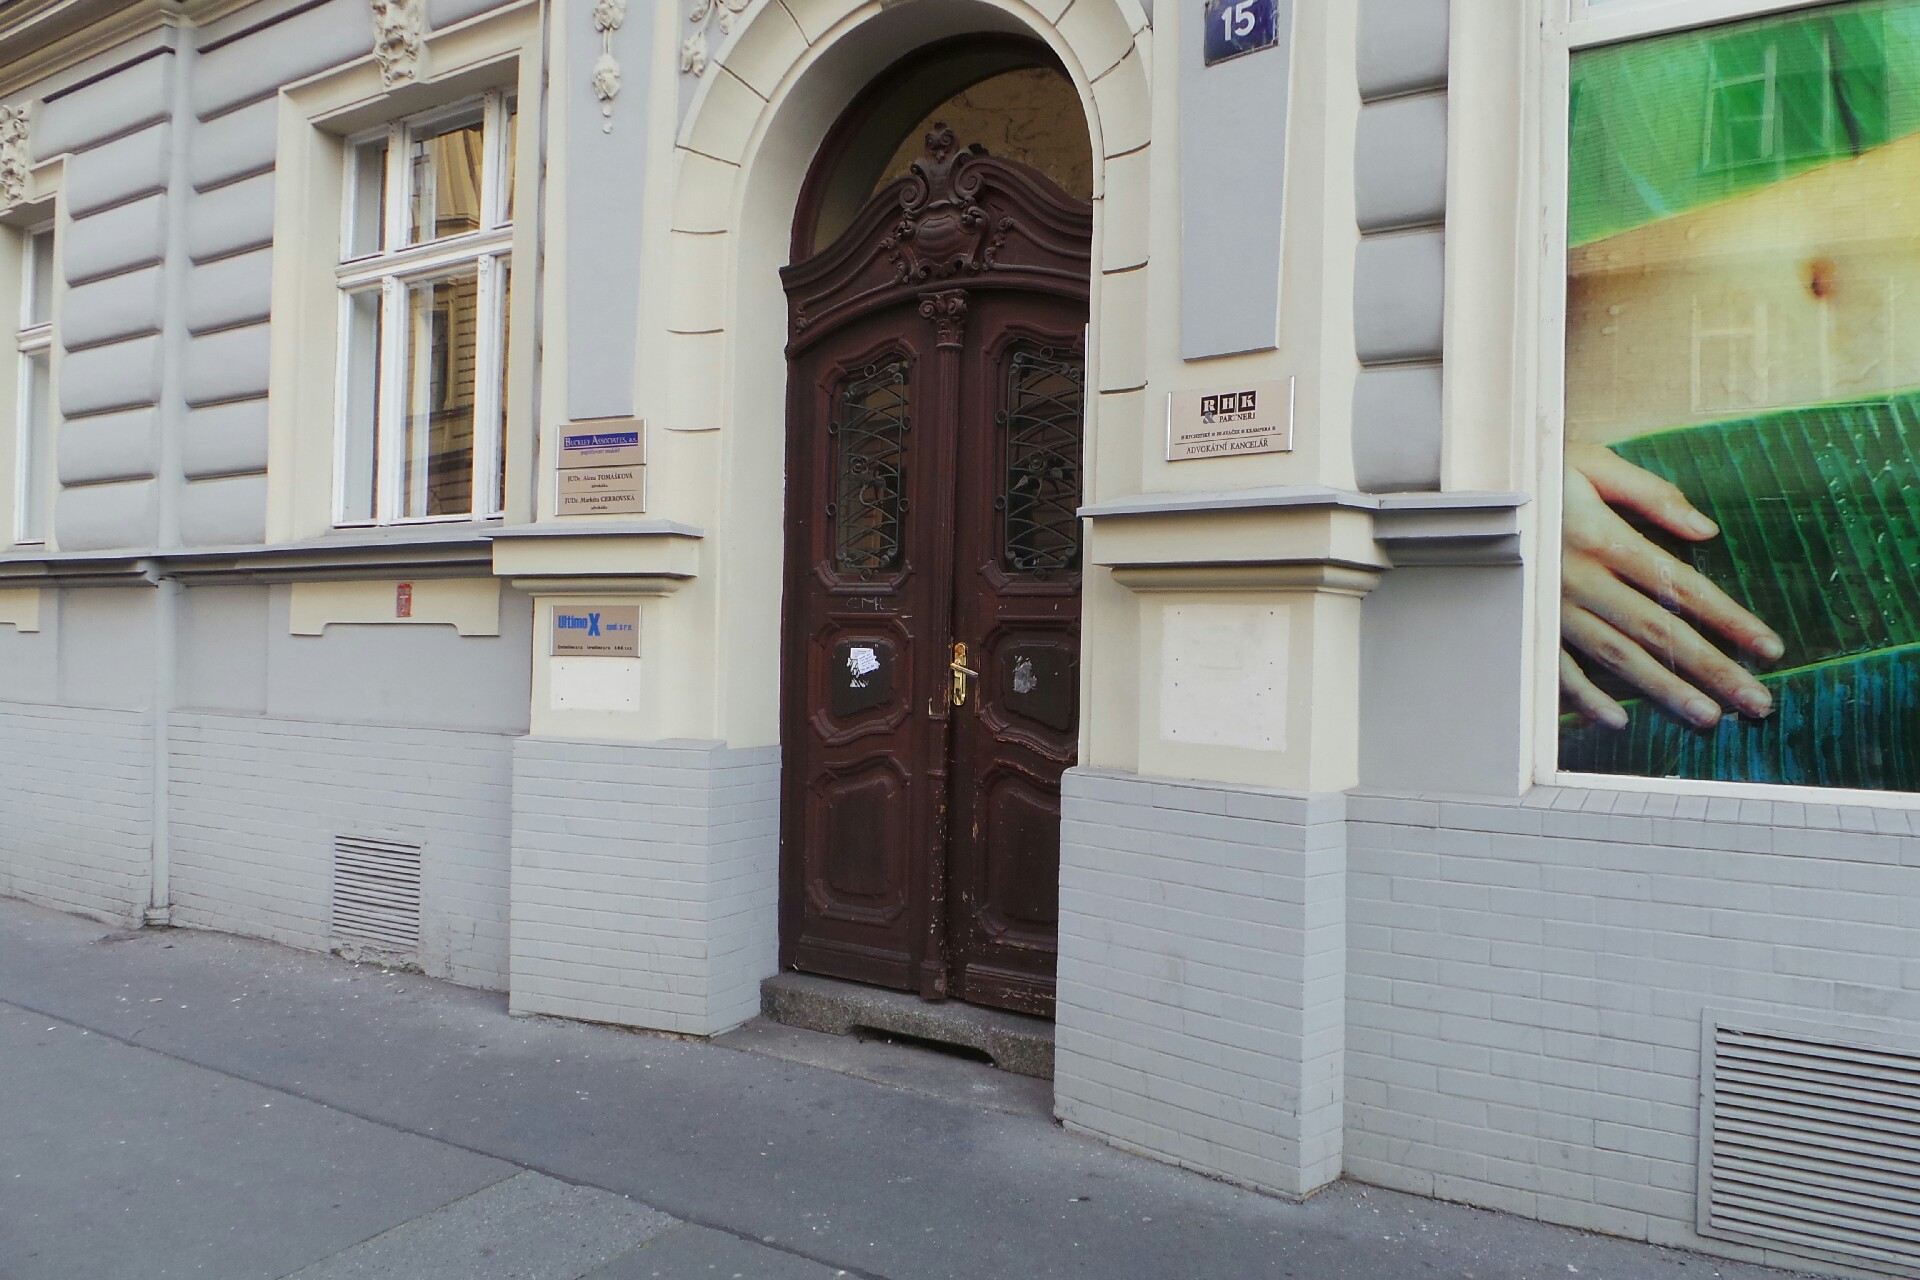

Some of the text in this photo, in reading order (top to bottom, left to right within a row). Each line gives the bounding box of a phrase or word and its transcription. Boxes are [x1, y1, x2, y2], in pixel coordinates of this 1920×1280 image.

[1221, 0, 1256, 41] 15
[1203, 394, 1255, 412] RHK
[1202, 411, 1216, 424] &
[1186, 438, 1268, 454] ADVOKÁTNÍ KANCELÁŘ
